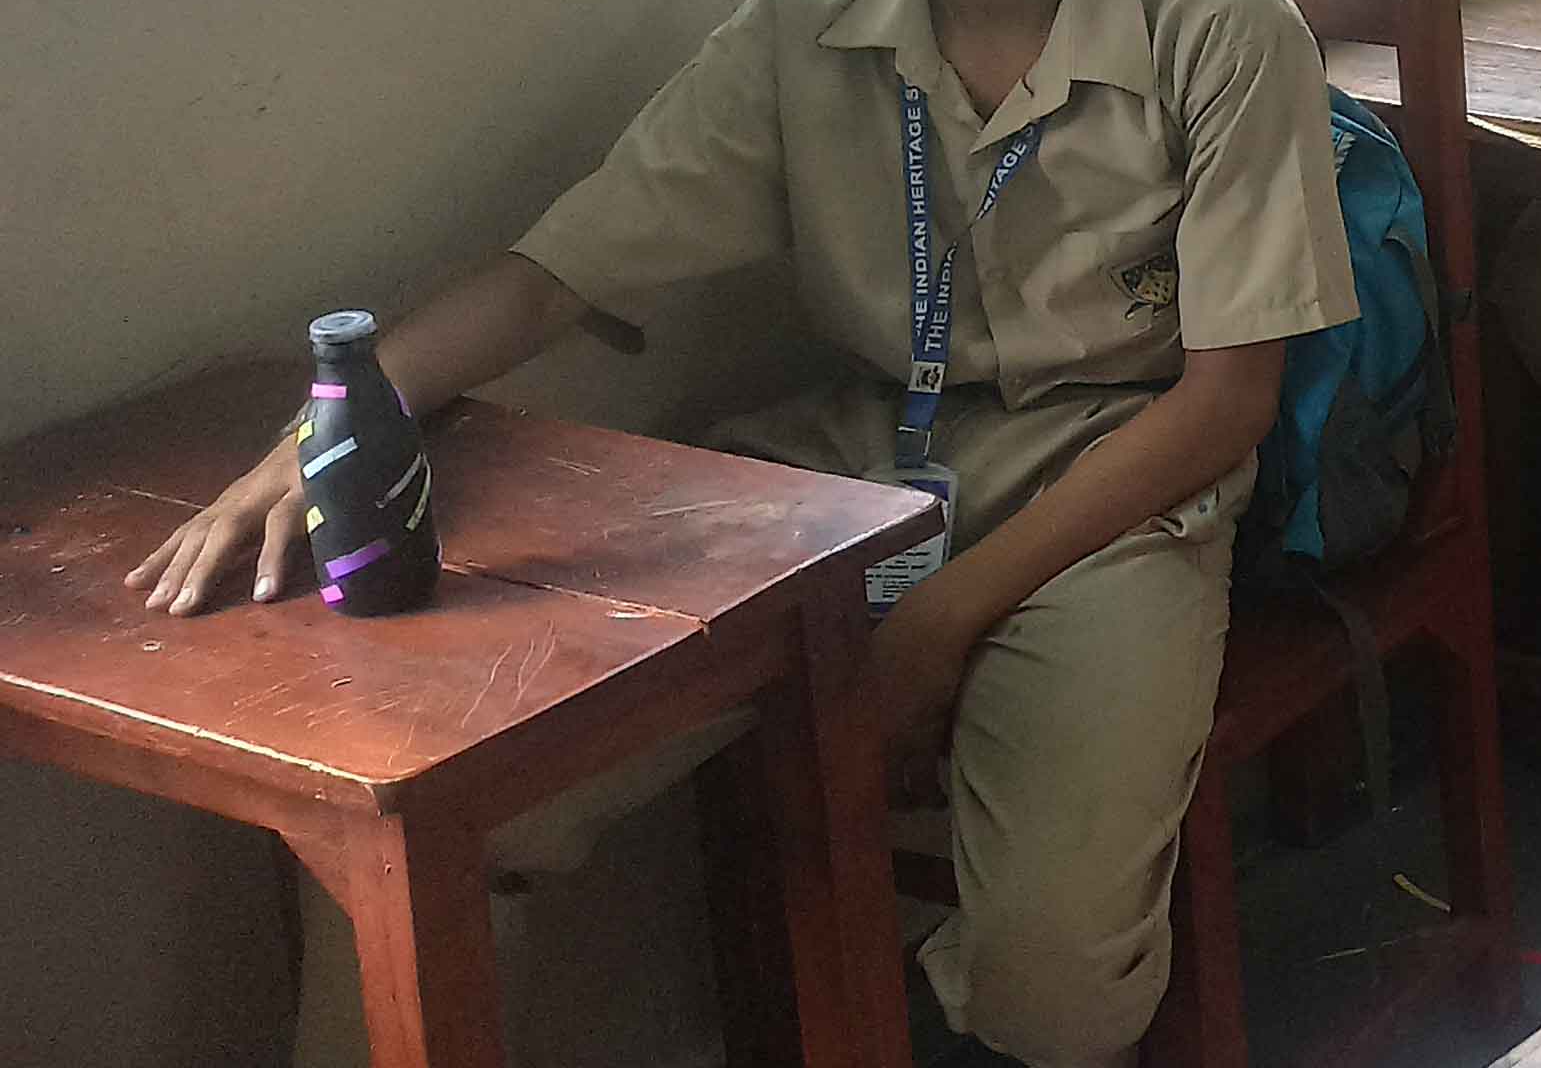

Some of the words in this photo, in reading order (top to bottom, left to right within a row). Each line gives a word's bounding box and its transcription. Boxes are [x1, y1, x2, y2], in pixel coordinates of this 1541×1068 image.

[907, 107, 928, 215] HERITAGE
[913, 220, 929, 295] INDIAN
[924, 310, 949, 352] THE
